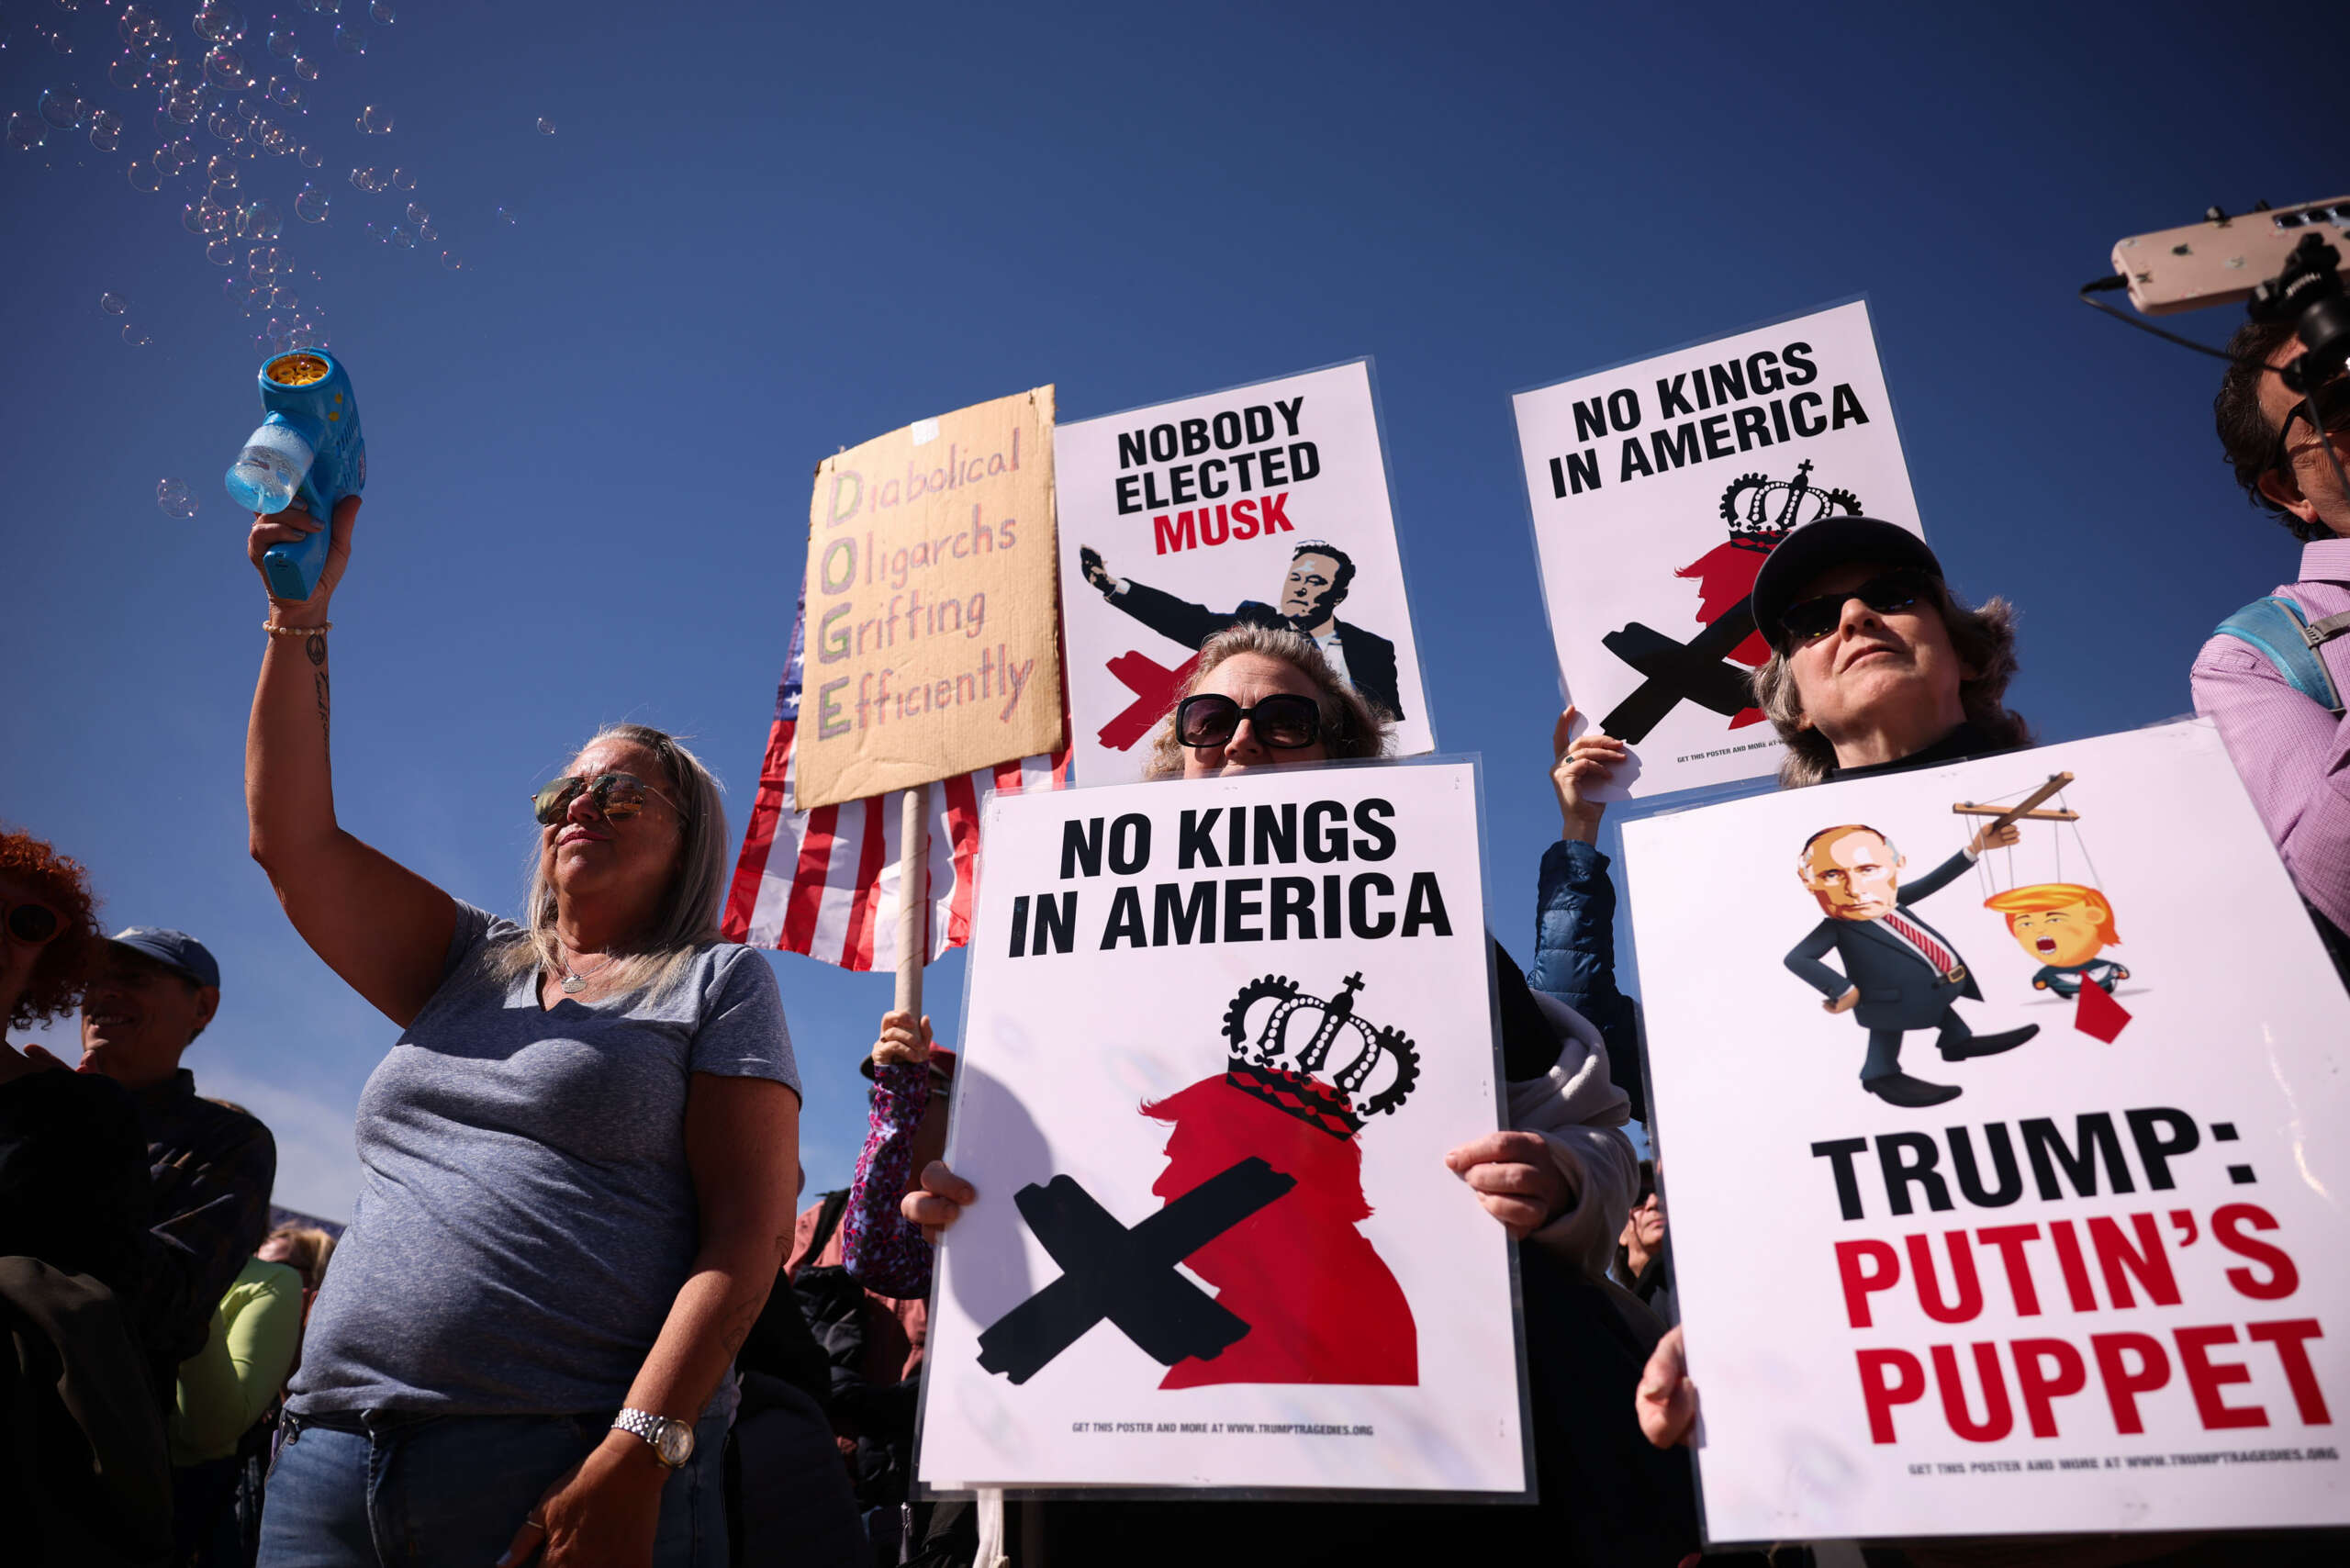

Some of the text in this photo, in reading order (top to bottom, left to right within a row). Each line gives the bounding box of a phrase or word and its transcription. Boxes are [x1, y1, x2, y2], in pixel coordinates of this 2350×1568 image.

[1118, 396, 1304, 469] NOBODY
[1572, 342, 1818, 442] NO KINGS
[826, 427, 1020, 529] Diabolical
[1115, 442, 1320, 515] ELECTED
[1550, 383, 1870, 498] IN AMERICA
[820, 503, 1017, 595] Oligarchs
[1153, 492, 1294, 555] MUSK
[817, 589, 985, 665] Grifting
[817, 644, 1034, 742] Efficiently
[1691, 753, 1705, 761] THIS
[1707, 748, 1731, 758] POSTER
[1732, 745, 1746, 754] AND
[1748, 742, 1767, 750] MORE
[1058, 798, 1397, 879] NO KINGS
[1008, 871, 1454, 958] IN AMERICA
[1811, 1106, 2257, 1222] TRUMP:
[1834, 1202, 2300, 1329] PUTIN'S
[1855, 1317, 2333, 1445] PUPPET
[1072, 1422, 1374, 1436] GET THIS POSTER AND MORE AT WWW.TRUMPTRAGEDIES.ORG
[1908, 1462, 1932, 1475] GET
[1937, 1462, 1966, 1474] THIS
[1970, 1460, 2021, 1473] POSTER
[2026, 1459, 2054, 1472] AND
[2058, 1456, 2099, 1471] MORE
[2104, 1455, 2121, 1469] AT
